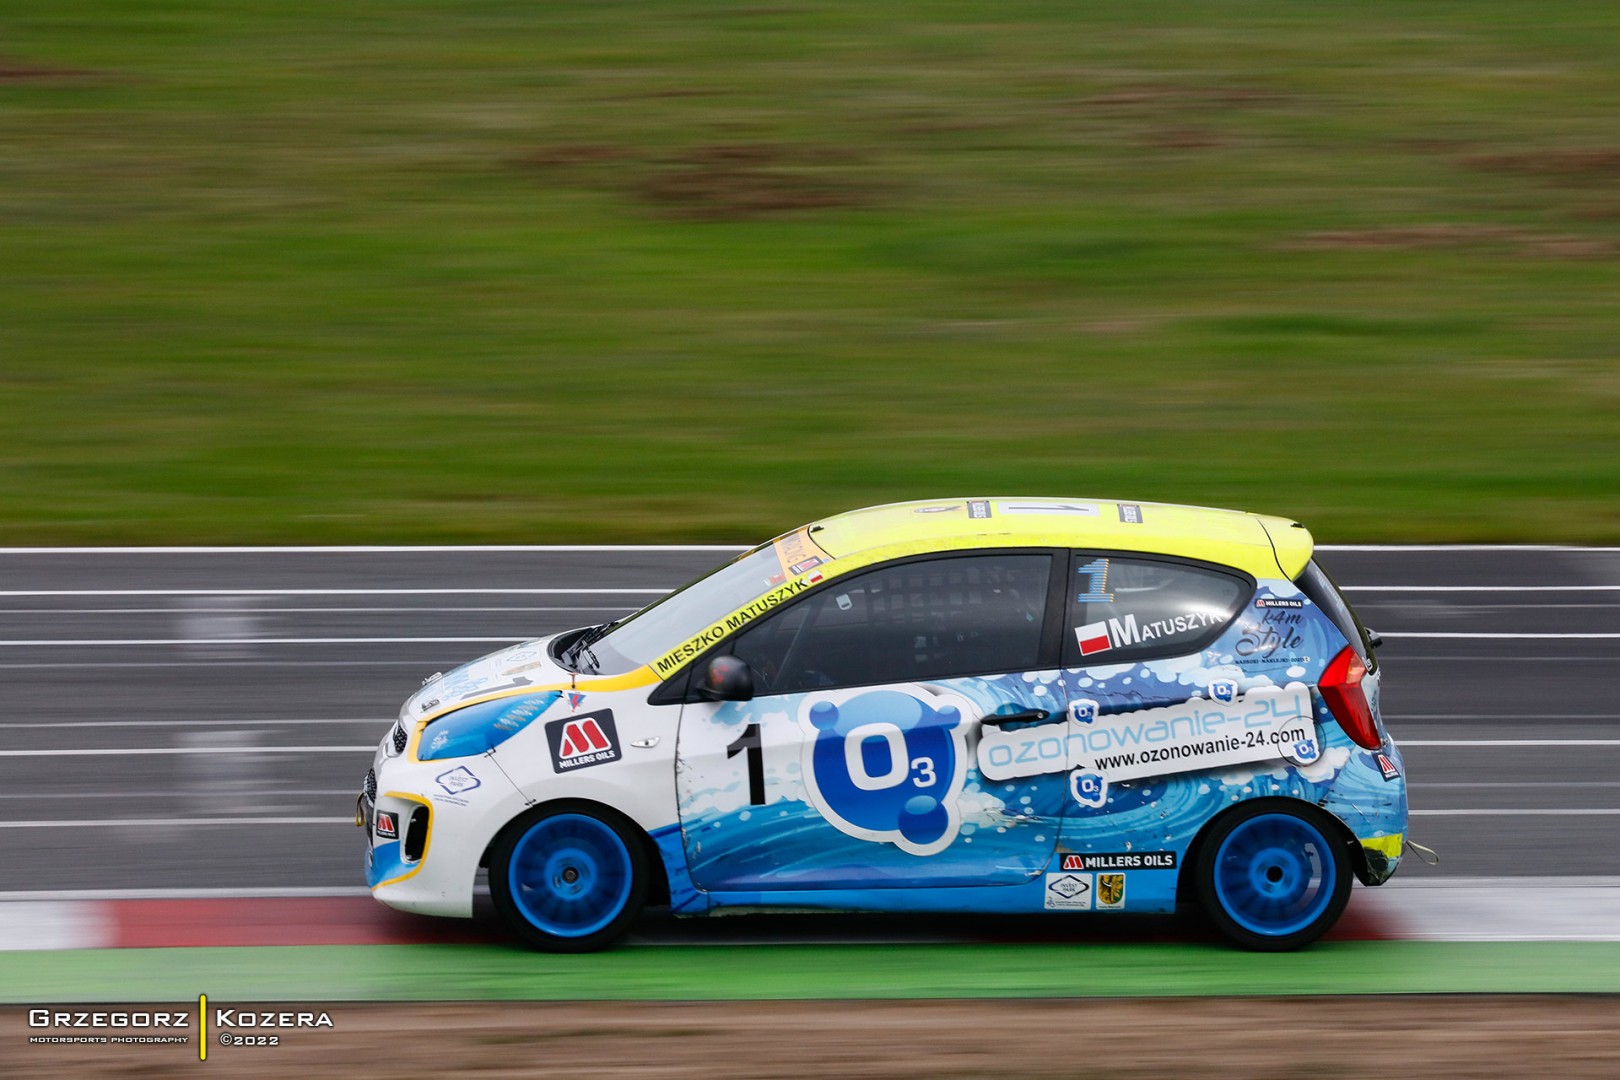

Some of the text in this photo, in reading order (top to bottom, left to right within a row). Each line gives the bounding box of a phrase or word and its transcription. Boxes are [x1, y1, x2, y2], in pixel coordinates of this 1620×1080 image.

[1078, 558, 1114, 602] 1
[656, 578, 808, 672] MIESZKO MATUSZYK
[1107, 613, 1223, 648] MATUSZYK
[988, 694, 1300, 767] ozonowanie-24
[1094, 728, 1305, 770] www.ozonowanie-24.com
[559, 750, 616, 768] MILLERS OILS
[726, 723, 766, 805] 1
[844, 722, 937, 791] O3
[1085, 855, 1173, 868] MILLERS OILS
